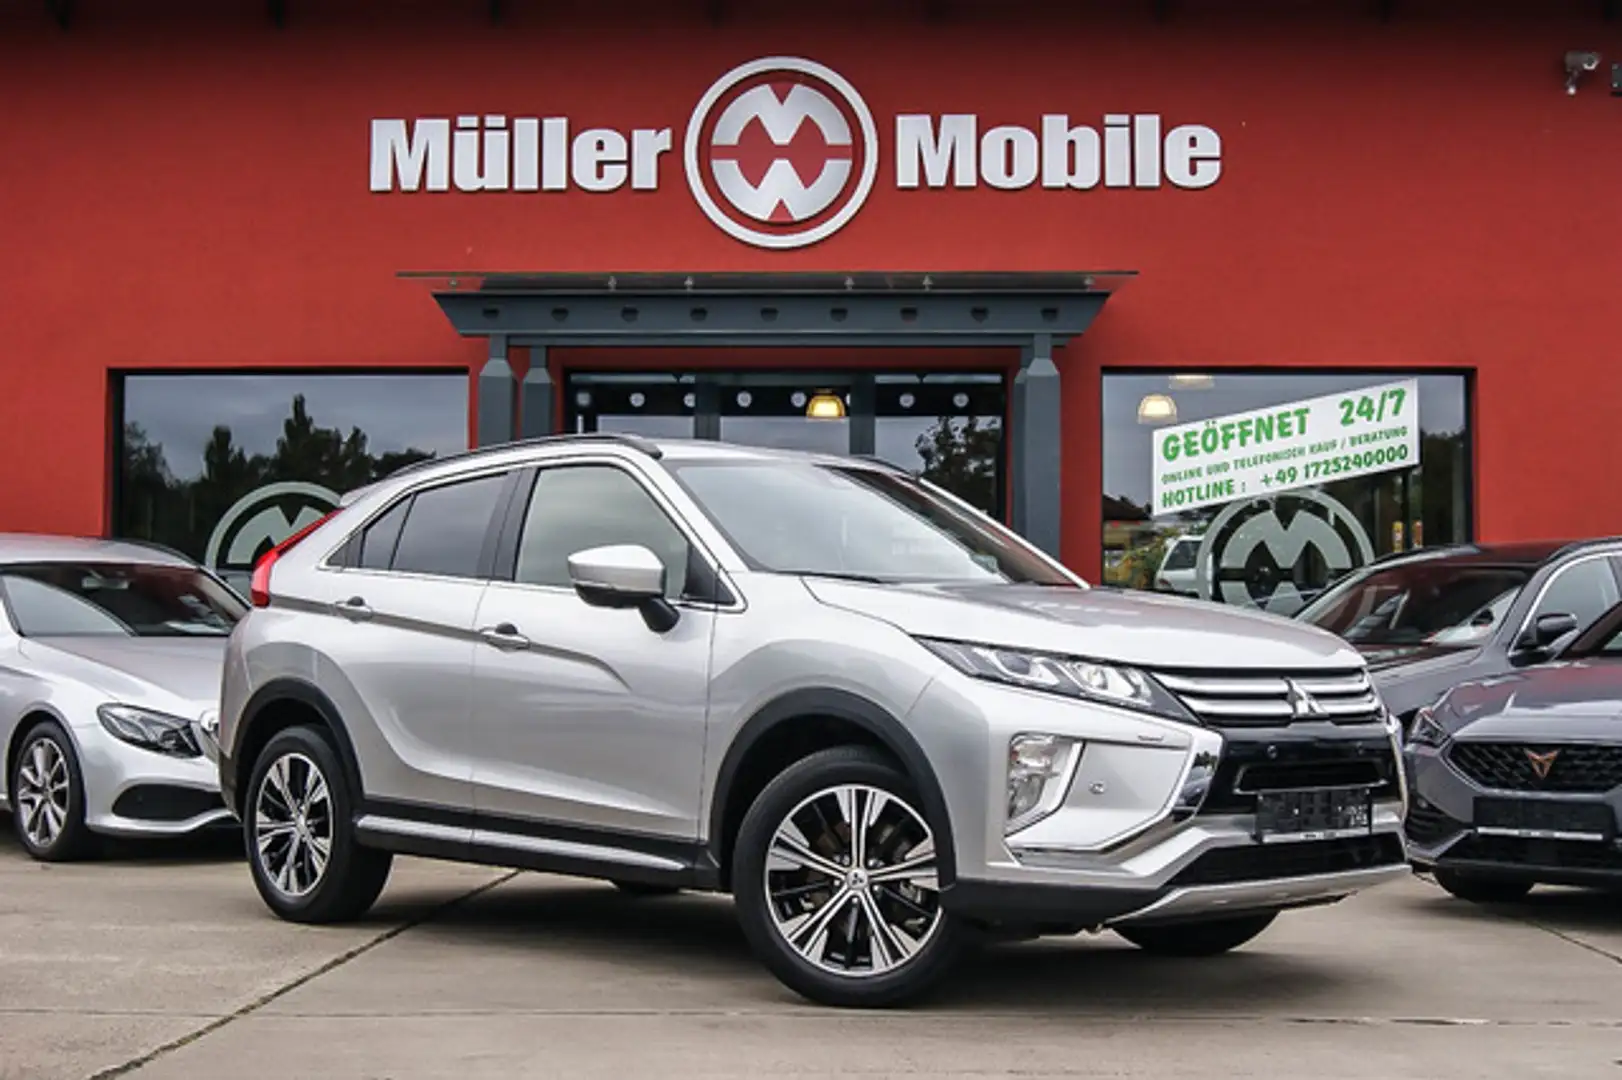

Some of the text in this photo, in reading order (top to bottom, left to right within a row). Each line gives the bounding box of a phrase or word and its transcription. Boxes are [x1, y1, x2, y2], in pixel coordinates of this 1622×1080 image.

[369, 113, 1222, 192] Müller Mobile
[1161, 387, 1406, 462] GEÖFFNET 24/7
[1161, 466, 1203, 485] ONLINE
[1206, 461, 1230, 475] UND
[1233, 445, 1306, 470] TELEFONISCH
[1309, 439, 1337, 454] KAUF
[1349, 425, 1408, 447] BERATUNG
[1161, 478, 1235, 507] HOTLINE
[1304, 443, 1408, 479] 1725240000
